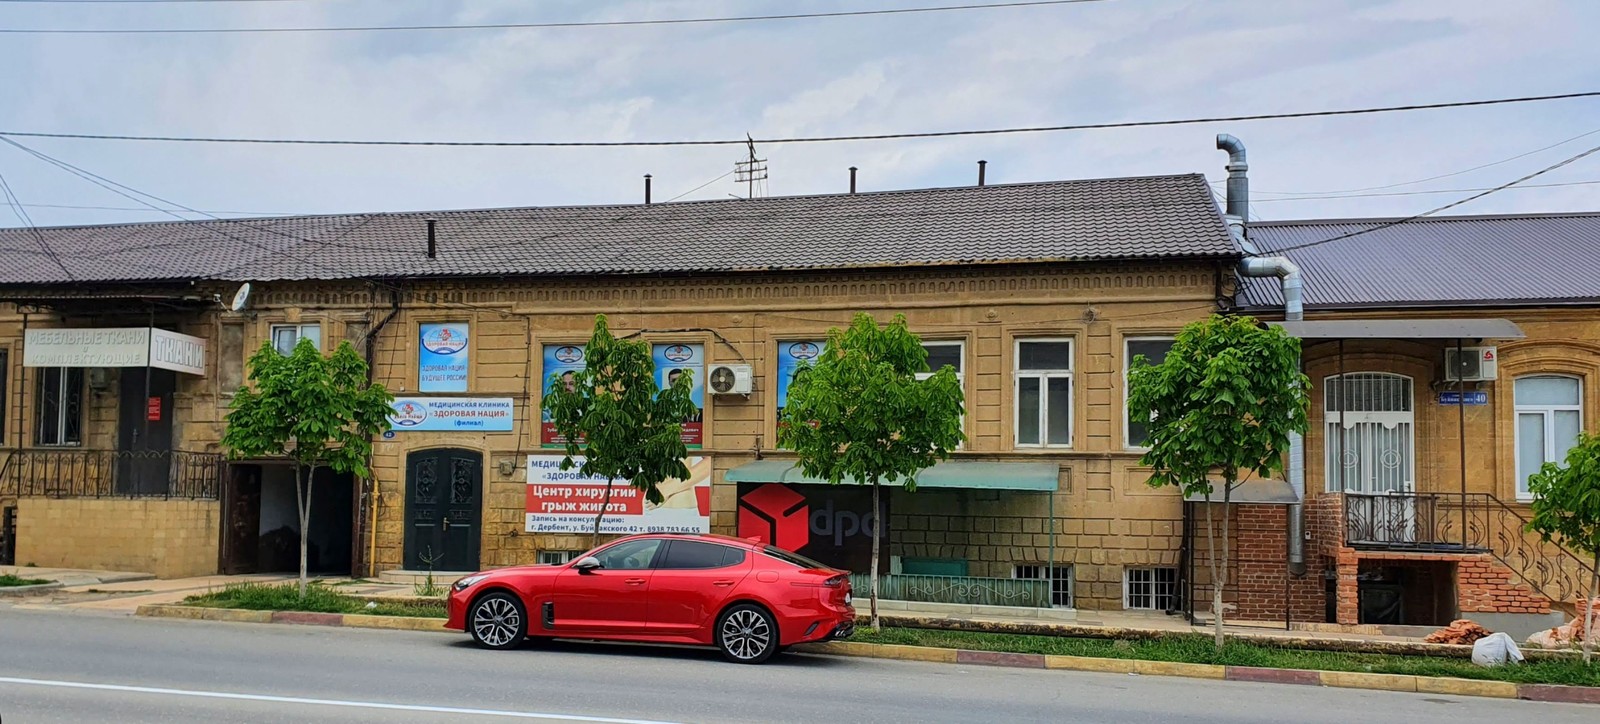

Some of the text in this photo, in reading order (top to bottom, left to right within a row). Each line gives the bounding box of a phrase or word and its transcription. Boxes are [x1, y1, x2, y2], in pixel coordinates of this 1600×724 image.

[28, 330, 146, 345] МЕБЕЛЬНЫЕ ТКАНИ
[155, 335, 204, 369] ТКАНИ
[31, 353, 141, 366] КОМПЛЕКТУЮЩИЕ
[1476, 394, 1486, 403] 40
[533, 485, 572, 499] Центр
[541, 501, 577, 512] грыж
[568, 516, 625, 524] консулацию:
[810, 499, 887, 546] dpd
[537, 523, 572, 532] Дербент,
[580, 524, 628, 532] Буйакского
